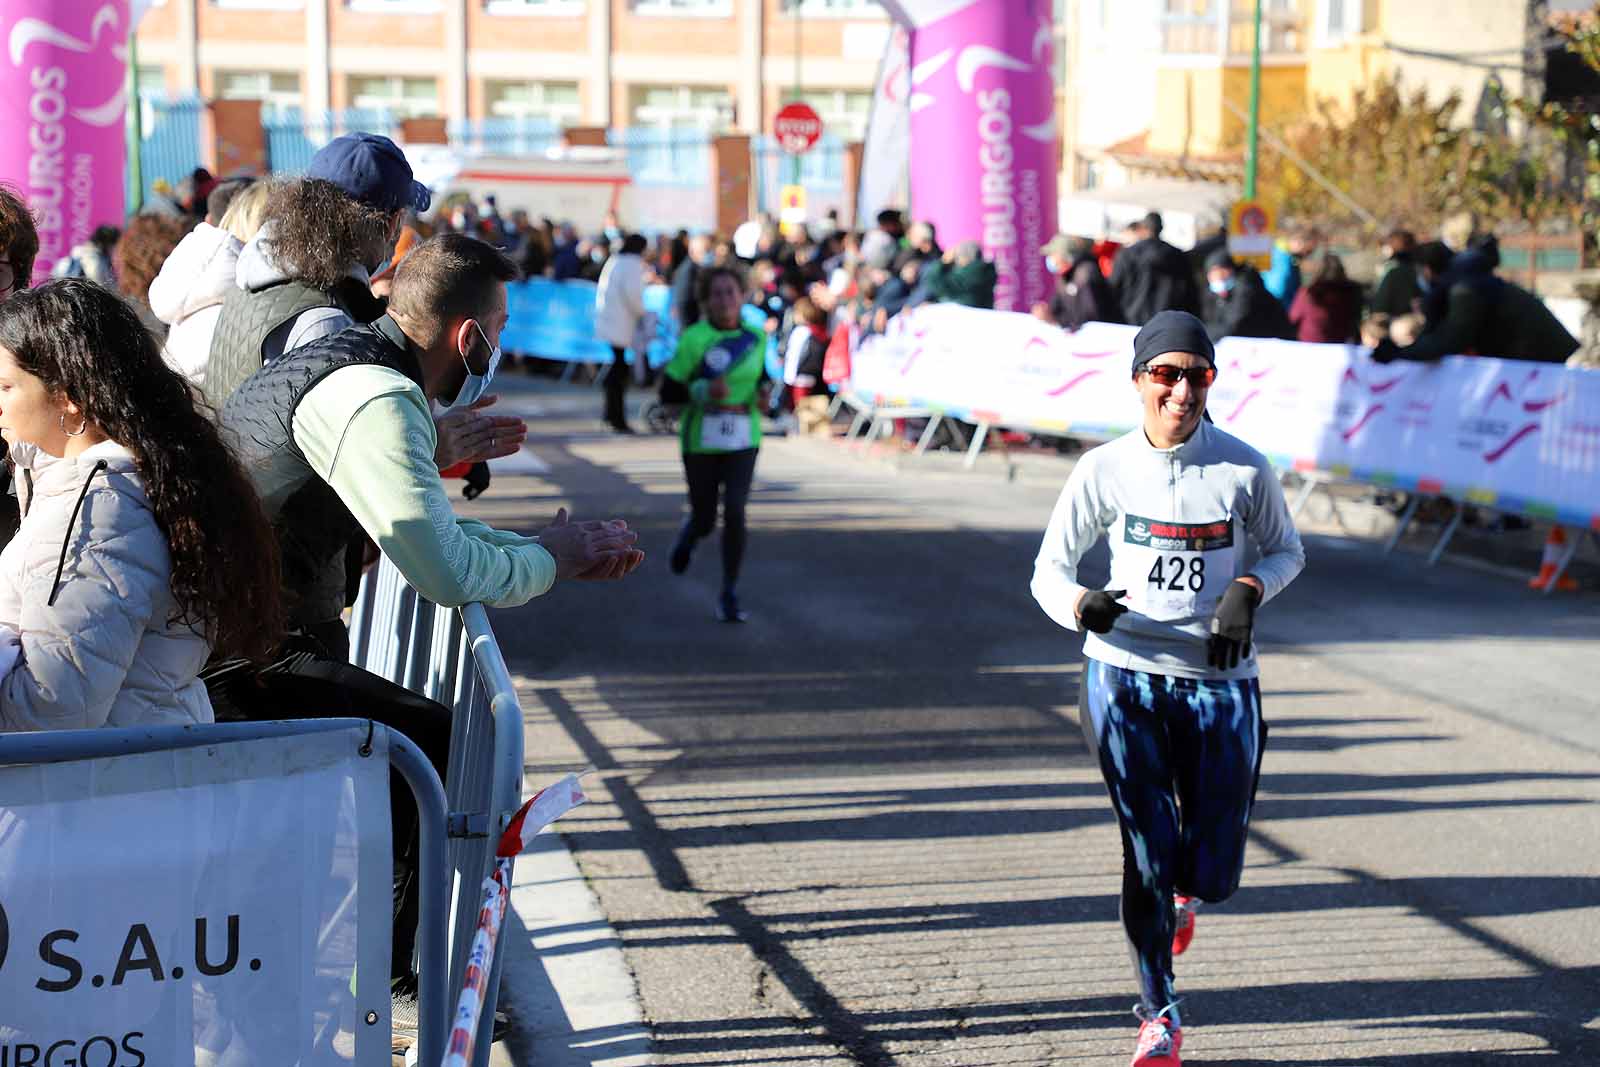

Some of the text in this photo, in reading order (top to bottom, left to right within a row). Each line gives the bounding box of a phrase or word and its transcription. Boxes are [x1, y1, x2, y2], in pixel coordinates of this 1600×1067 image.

[1148, 555, 1205, 593] 428
[35, 914, 262, 993] S.A.U.
[0, 1031, 146, 1067] RGOS
